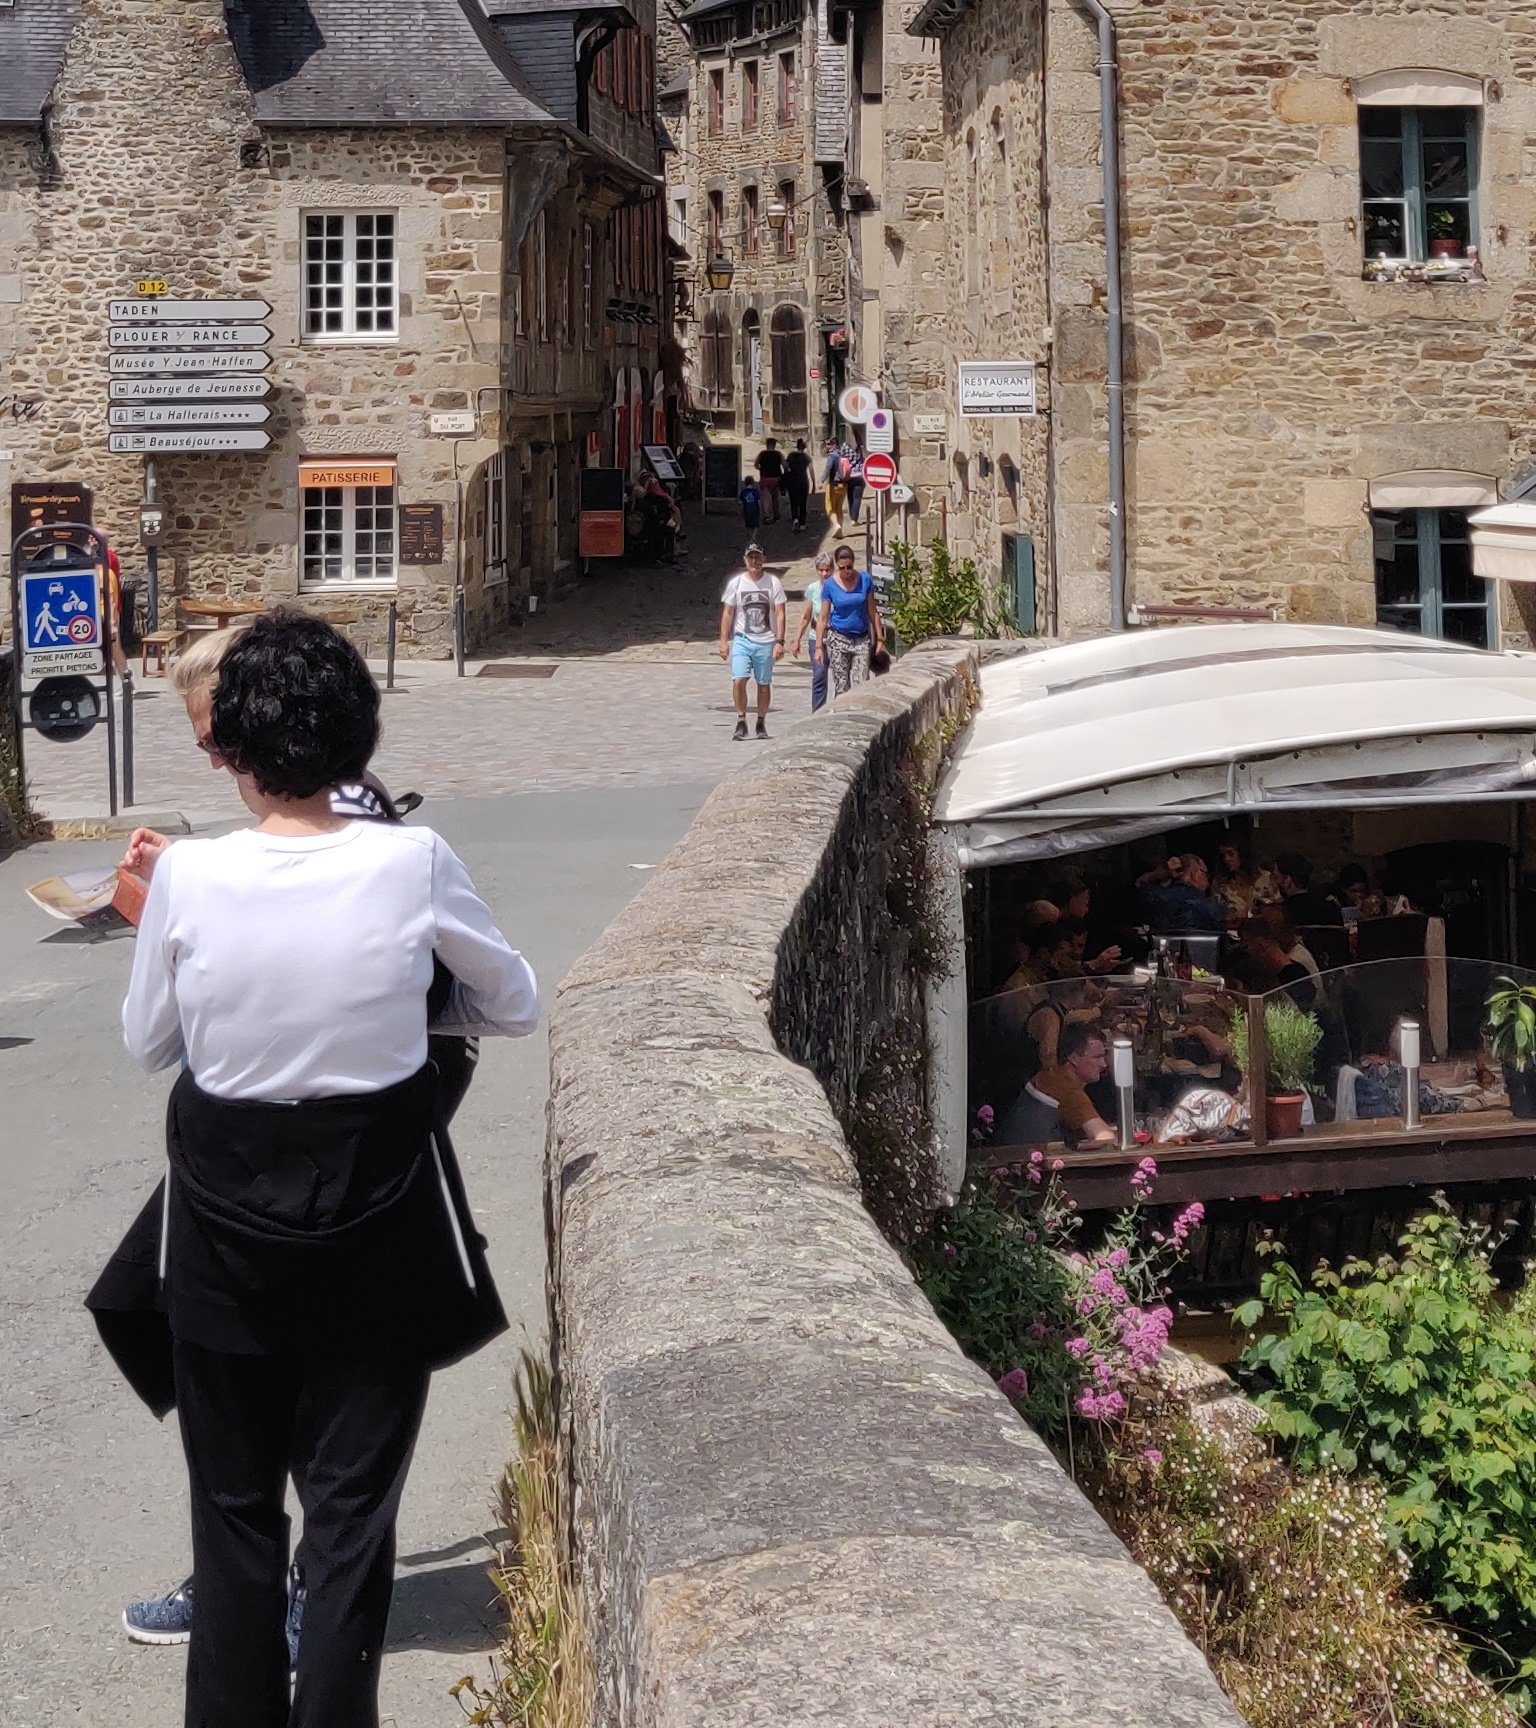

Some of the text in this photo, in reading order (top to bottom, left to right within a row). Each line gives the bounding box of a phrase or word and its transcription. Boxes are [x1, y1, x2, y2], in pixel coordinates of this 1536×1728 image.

[139, 282, 165, 292] D 12
[114, 305, 159, 315] TADEN
[114, 331, 169, 342] PLOUER
[193, 330, 239, 341] RANCE
[114, 357, 155, 368] Musée
[964, 377, 1030, 386] RESTAURANT
[132, 382, 262, 395] Auberge de Jeunesse
[149, 409, 220, 420] La Hallerais
[149, 436, 216, 448] Beauséjour
[73, 623, 90, 635] 20
[32, 655, 53, 663] ZONE
